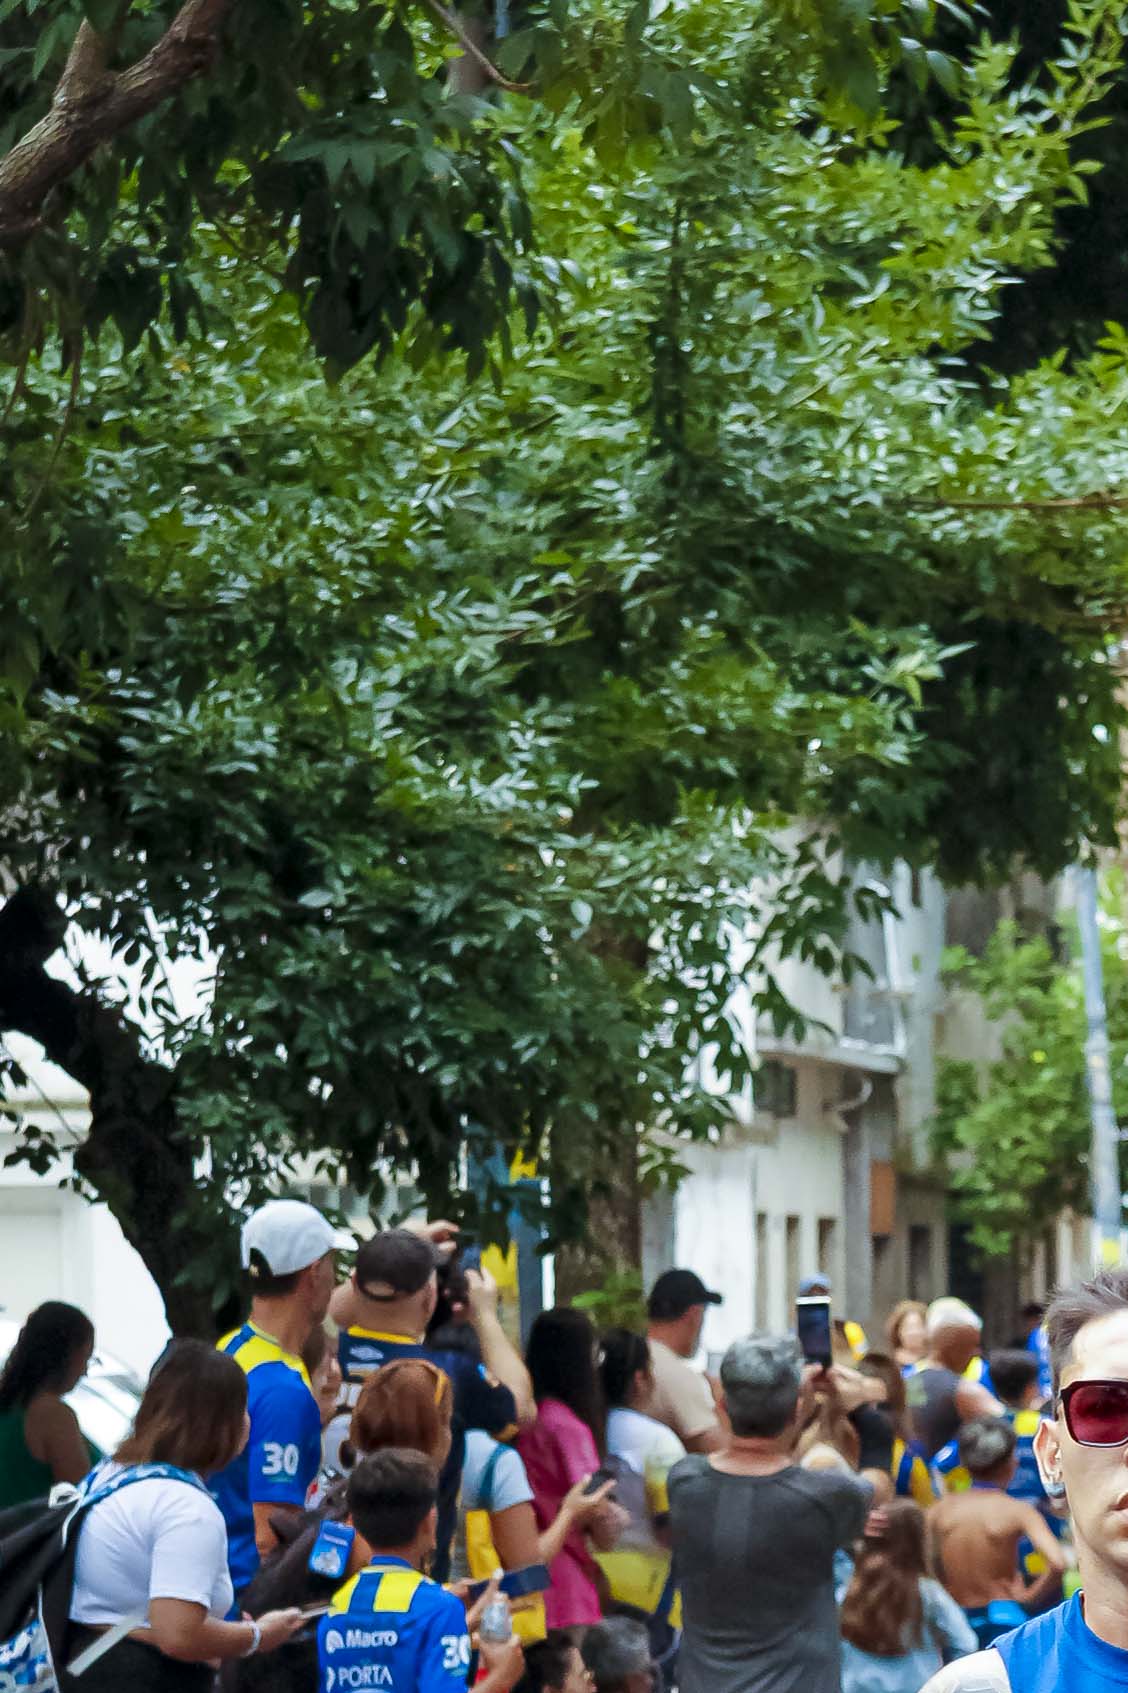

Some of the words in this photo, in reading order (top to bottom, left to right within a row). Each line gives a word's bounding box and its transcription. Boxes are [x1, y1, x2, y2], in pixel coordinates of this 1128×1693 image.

[262, 1441, 299, 1476] 30
[346, 1629, 398, 1648] Macro
[338, 1664, 393, 1687] PORTA
